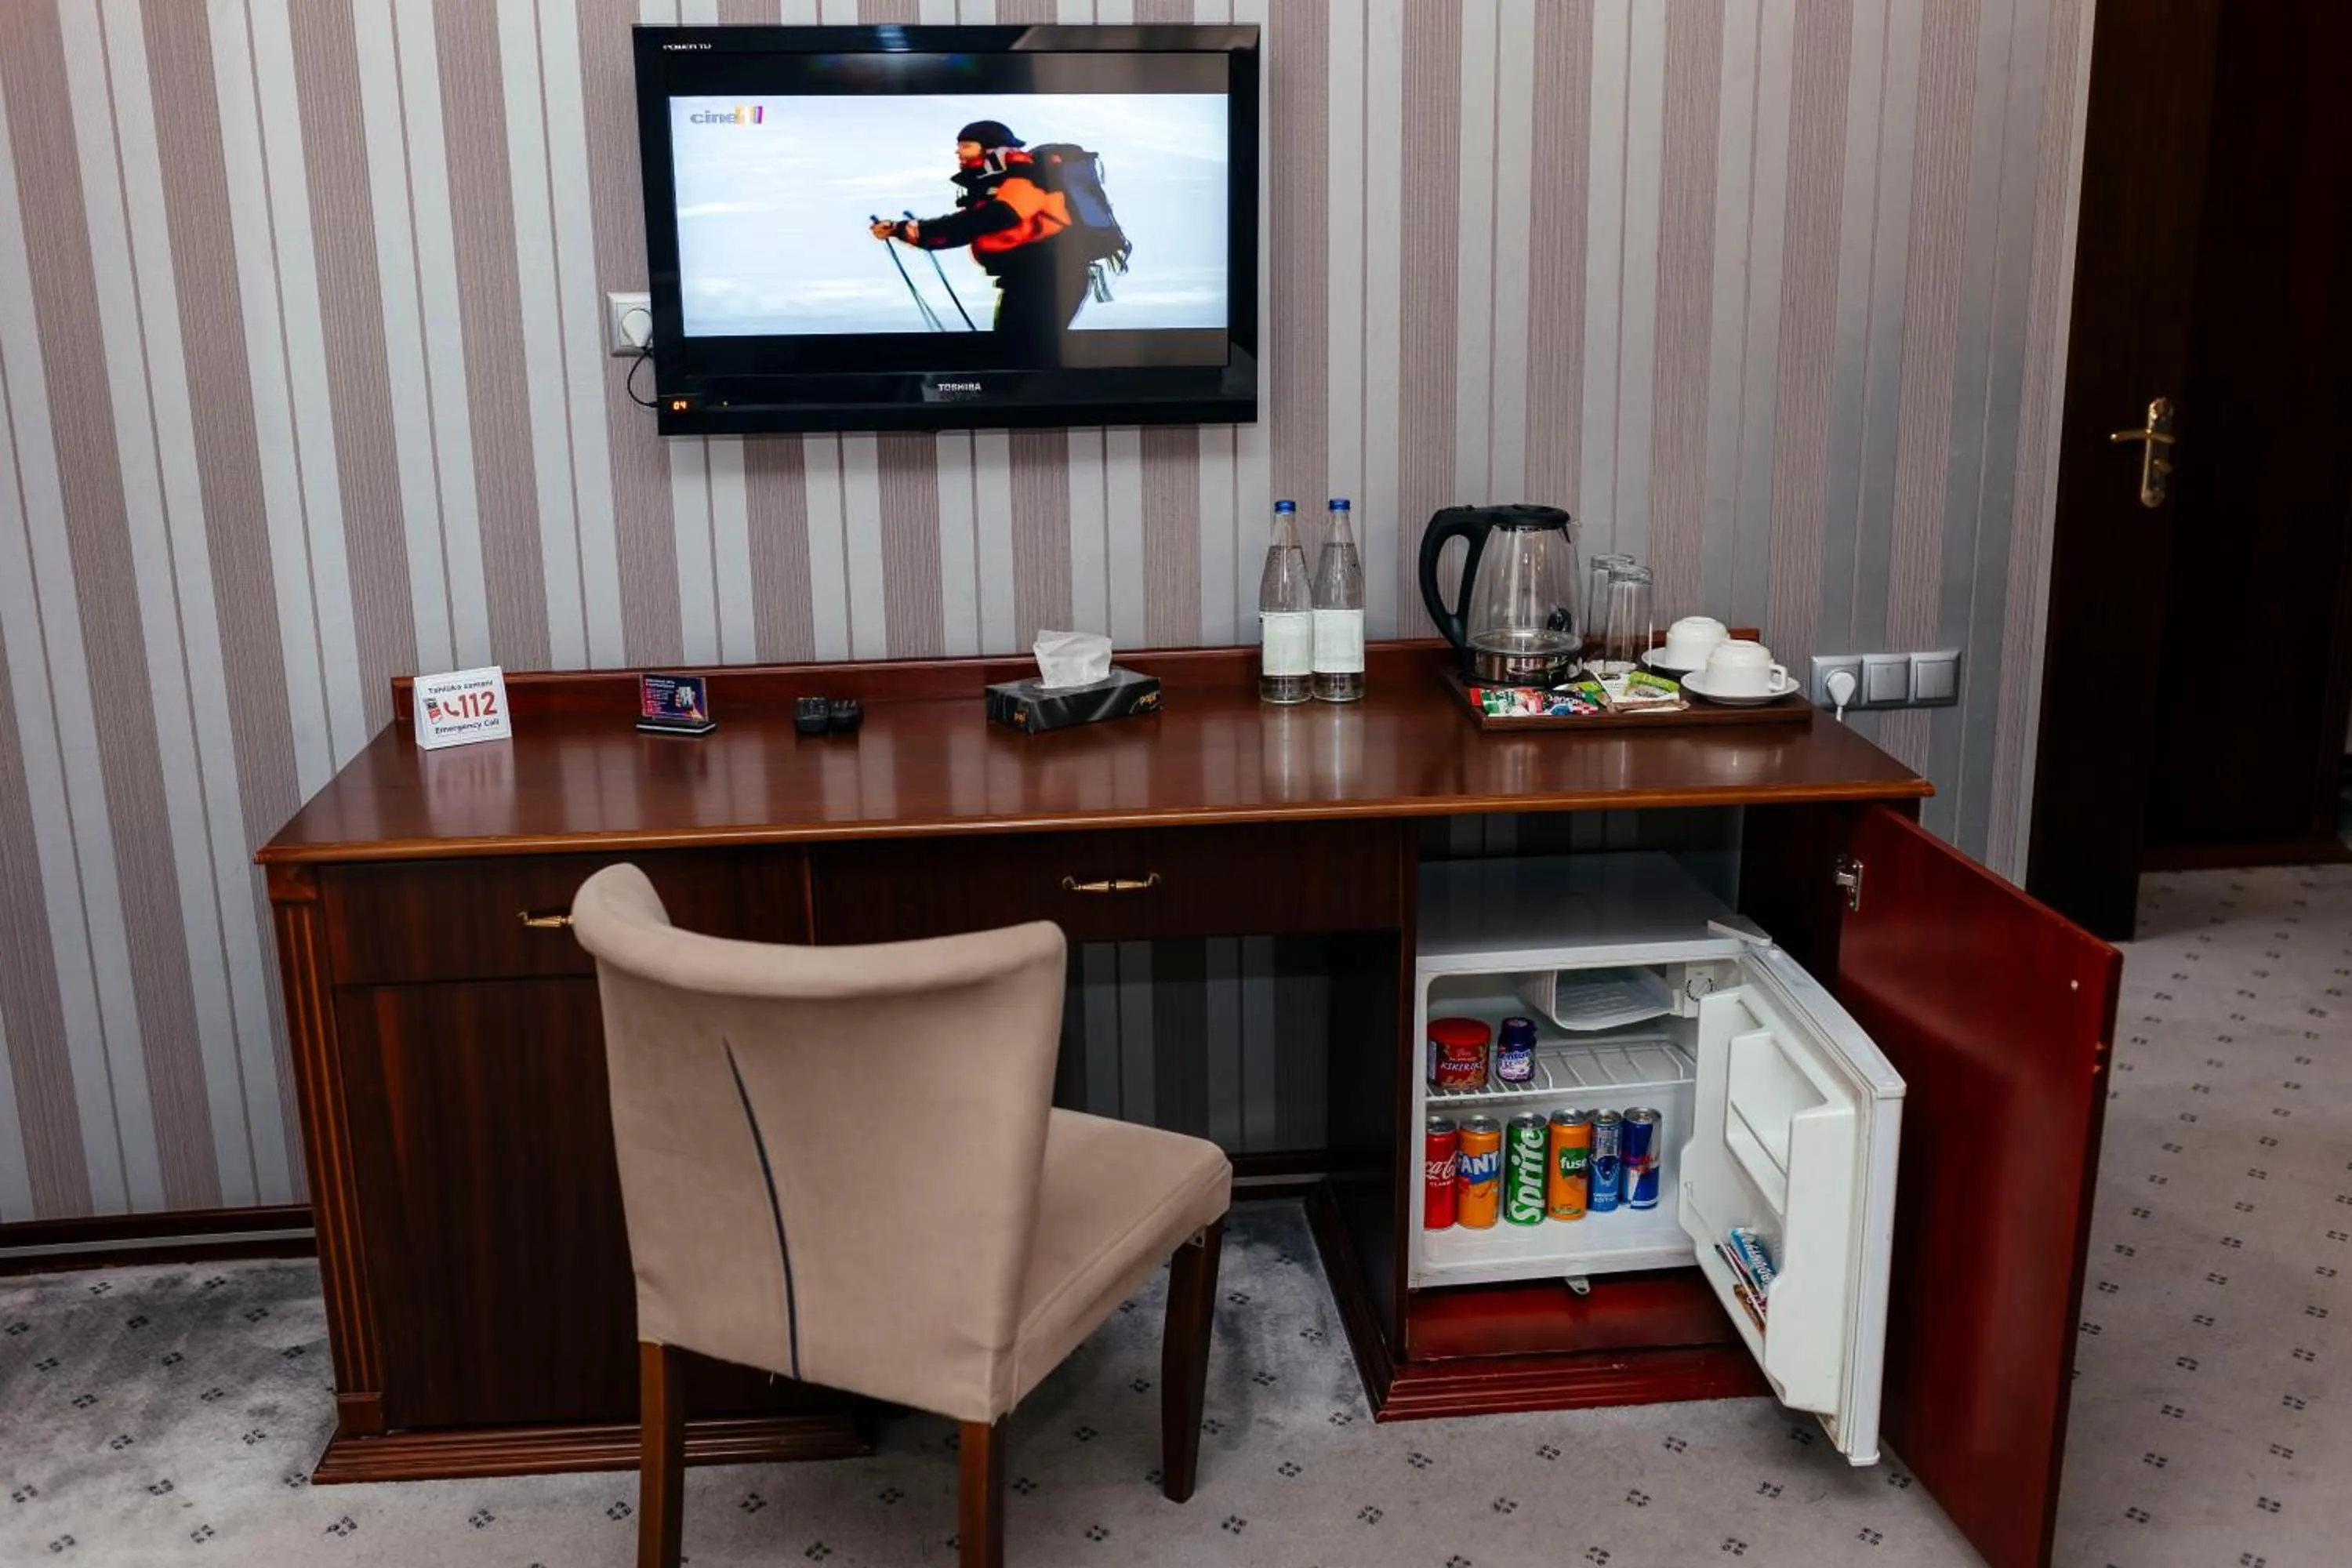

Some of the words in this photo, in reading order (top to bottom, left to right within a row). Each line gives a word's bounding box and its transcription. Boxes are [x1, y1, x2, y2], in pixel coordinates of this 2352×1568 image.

[938, 383, 982, 391] TOSHIBA
[458, 691, 498, 719] 112
[435, 721, 482, 735] Emergency
[484, 718, 499, 727] Call
[1511, 1128, 1545, 1221] Sprite
